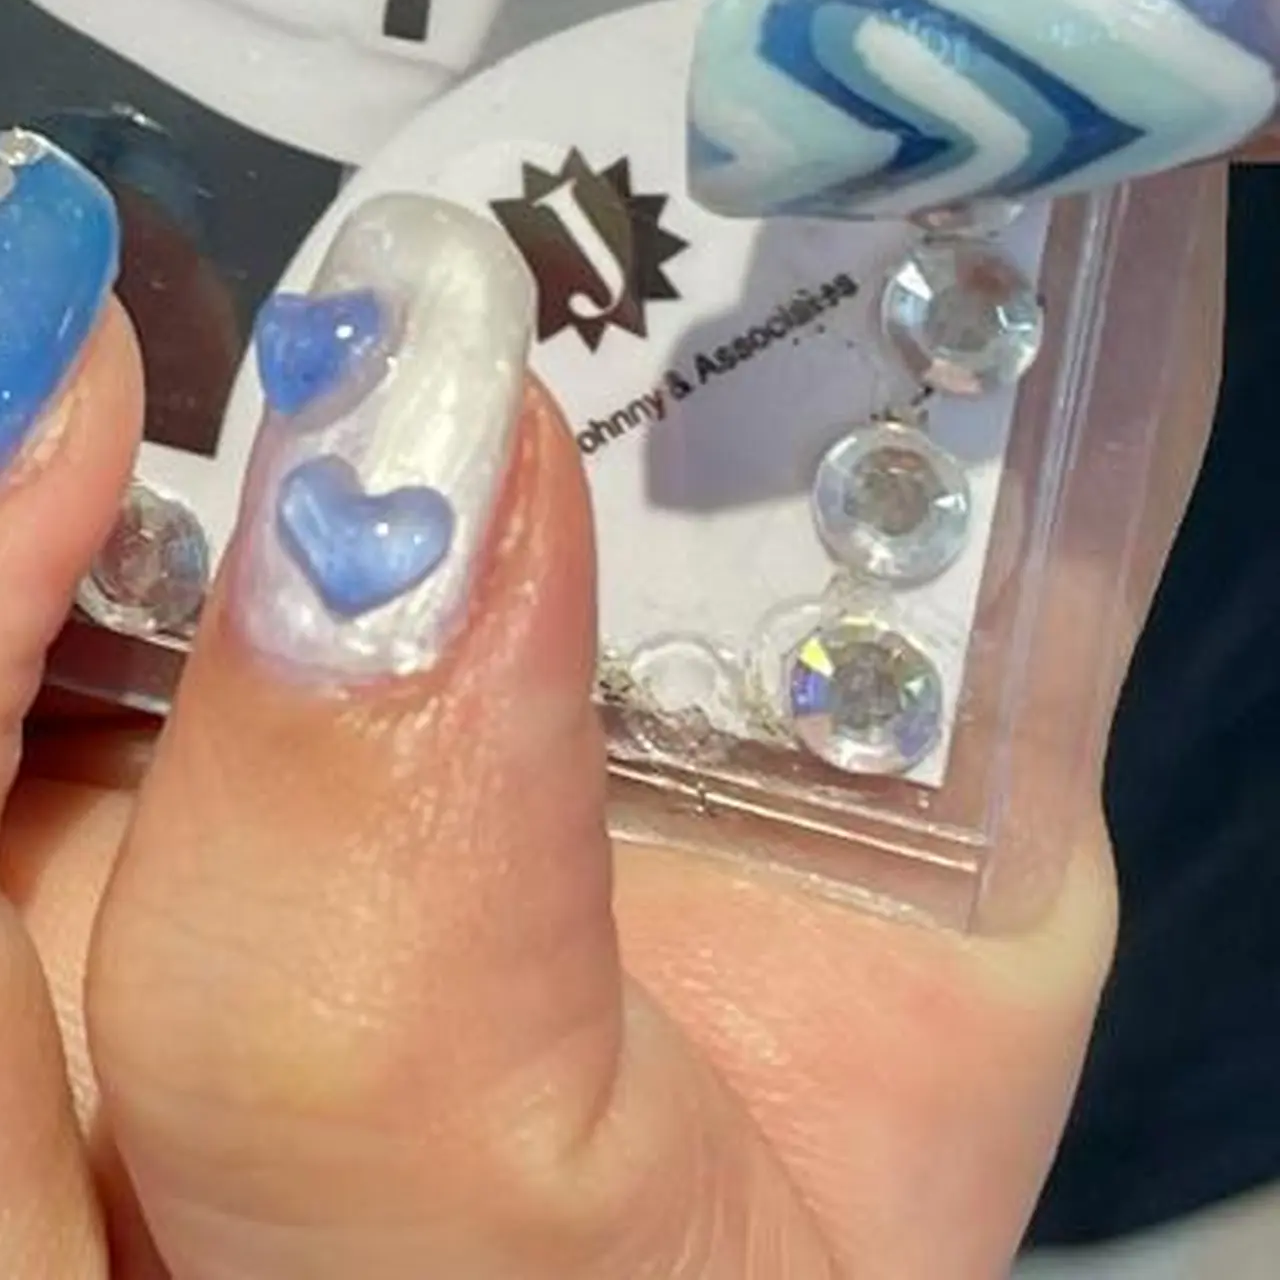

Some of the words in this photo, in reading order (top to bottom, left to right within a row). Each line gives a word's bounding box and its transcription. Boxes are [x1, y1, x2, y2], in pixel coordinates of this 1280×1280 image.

[531, 178, 629, 320] J
[576, 386, 667, 454] ohnny
[666, 370, 692, 400] &
